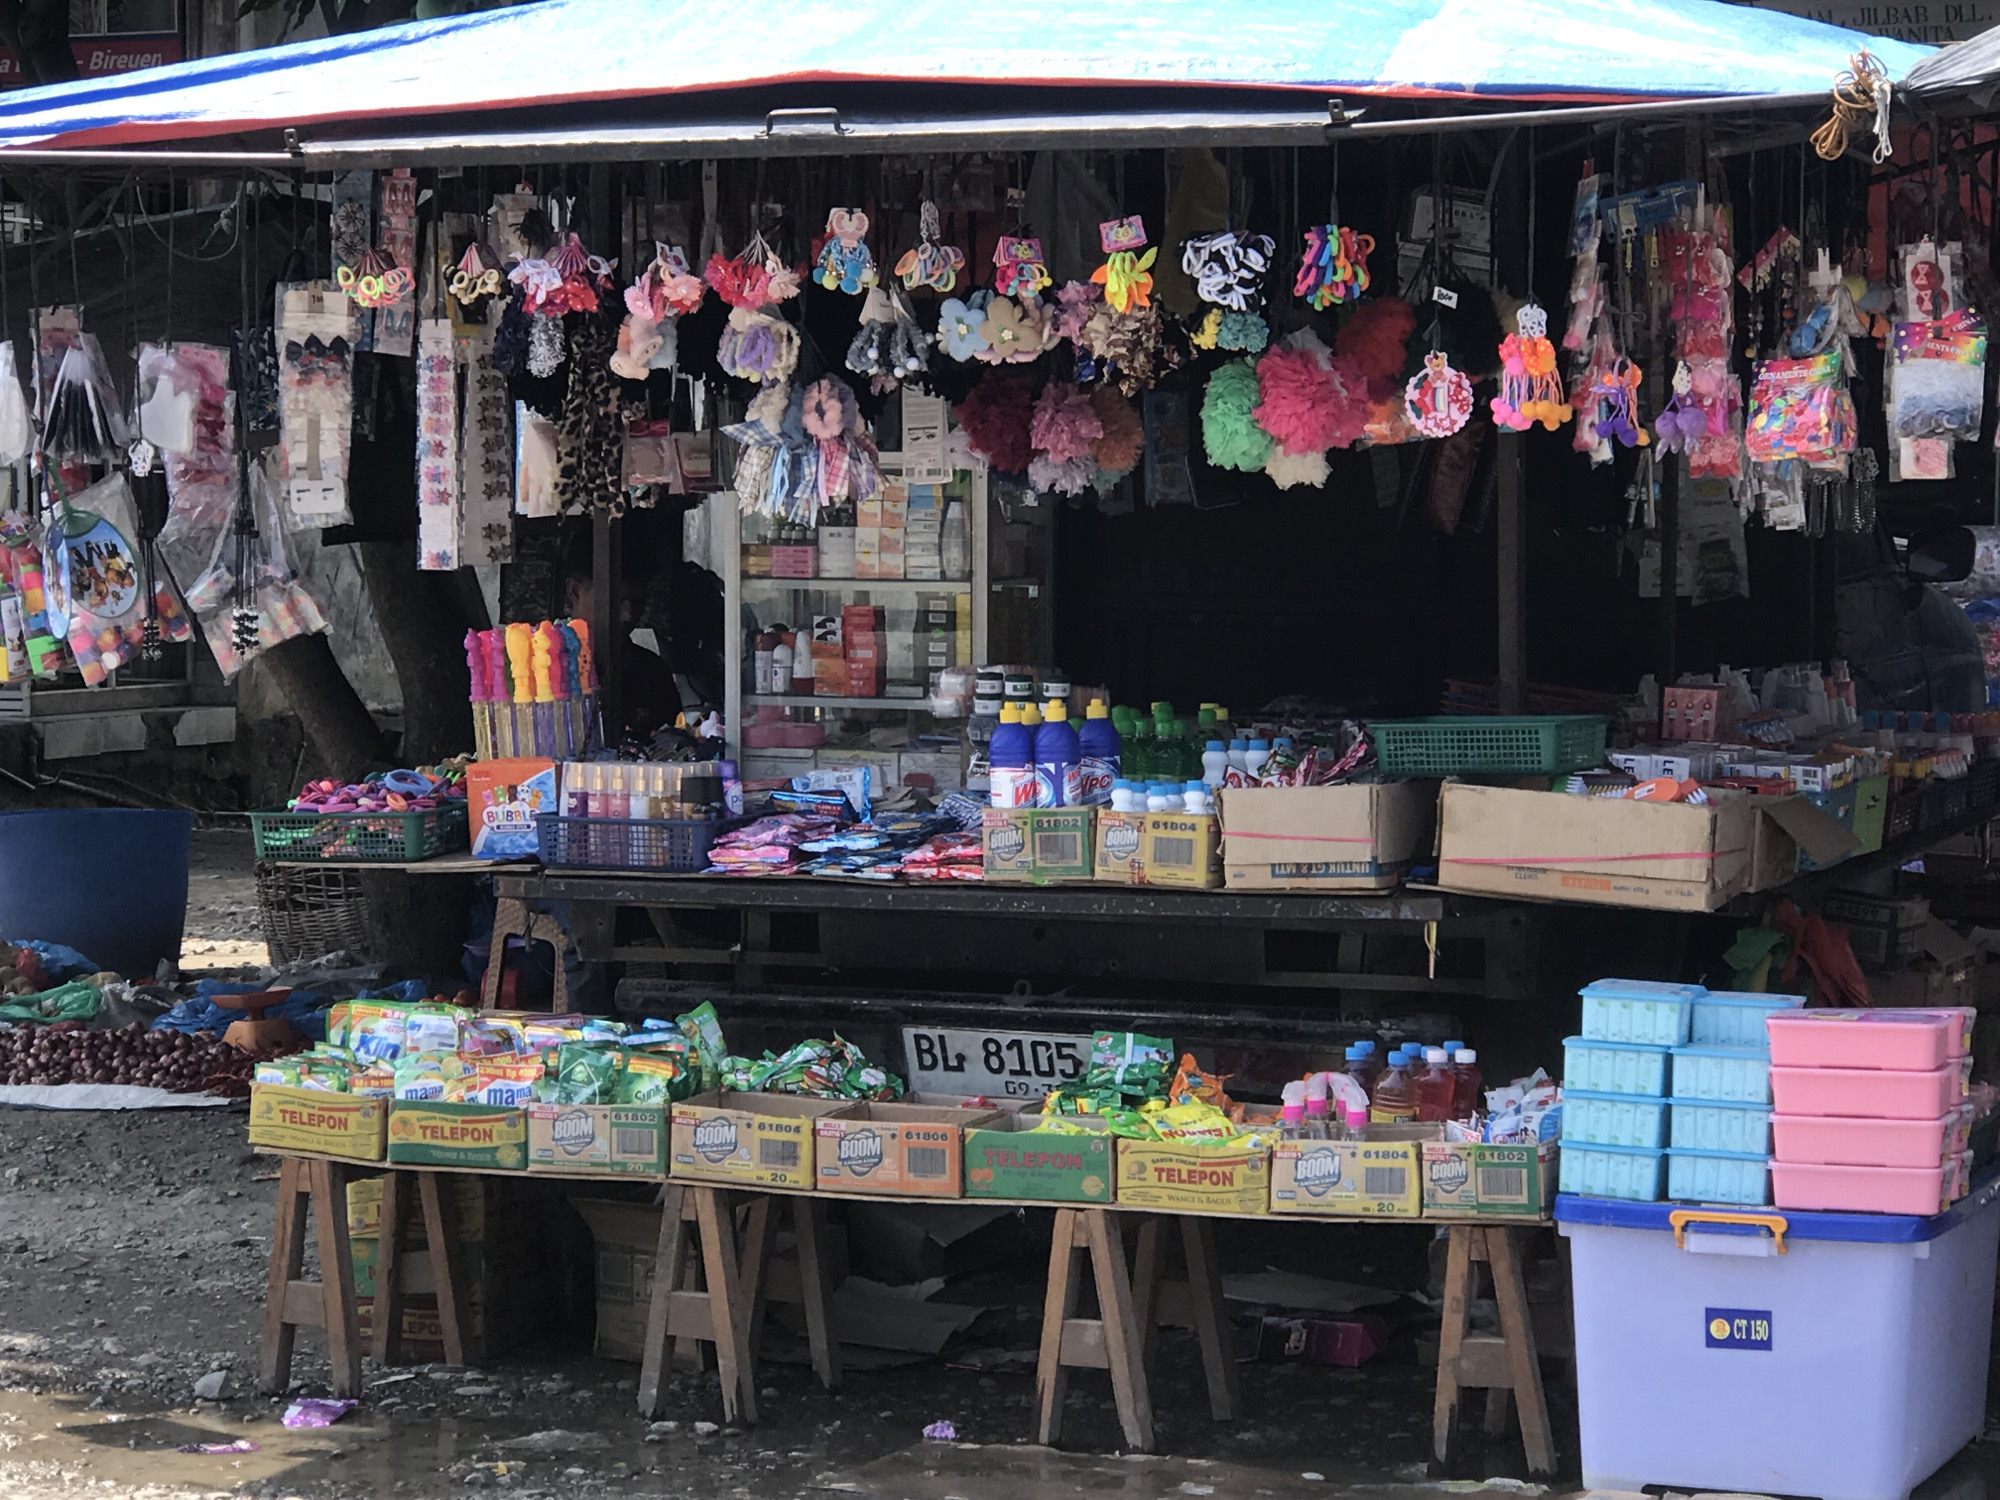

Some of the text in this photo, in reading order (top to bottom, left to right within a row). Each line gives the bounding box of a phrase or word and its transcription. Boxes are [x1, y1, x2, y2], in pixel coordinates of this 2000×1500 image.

[1853, 6, 1928, 27] JILBAB
[1945, 4, 1993, 23] DLL.
[89, 50, 162, 70] Bireuen
[1758, 368, 1808, 381] ORNAMENTS
[486, 810, 537, 823] BUBBLE
[1036, 818, 1079, 828] 61802
[1152, 820, 1197, 831] 61804
[991, 829, 1023, 848] BOOM
[1107, 829, 1138, 846] BOOM
[355, 1034, 401, 1059] Klin
[913, 1033, 1082, 1079] BL 8105
[404, 1085, 444, 1099] mama
[487, 1087, 532, 1105] mama
[279, 1109, 348, 1131] TELEPON
[614, 1112, 656, 1122] 61802
[419, 1125, 493, 1143] TELEPON
[554, 1117, 593, 1138] BOOM
[695, 1125, 736, 1145] BOOM
[758, 1122, 801, 1134] 61804
[905, 1131, 948, 1141] 61806
[841, 1138, 880, 1159] BOOM
[1363, 1150, 1409, 1159] 61804
[1477, 1152, 1525, 1161] 61802
[627, 1163, 643, 1173] 20
[983, 1150, 1082, 1169] TELEPON
[1297, 1155, 1340, 1179] BOOM
[770, 1173, 787, 1183] 20
[1154, 1166, 1234, 1187] TELEPON
[1432, 1161, 1466, 1179] BOOM
[1376, 1202, 1395, 1213] 20
[1733, 1318, 1769, 1341] CT 150
